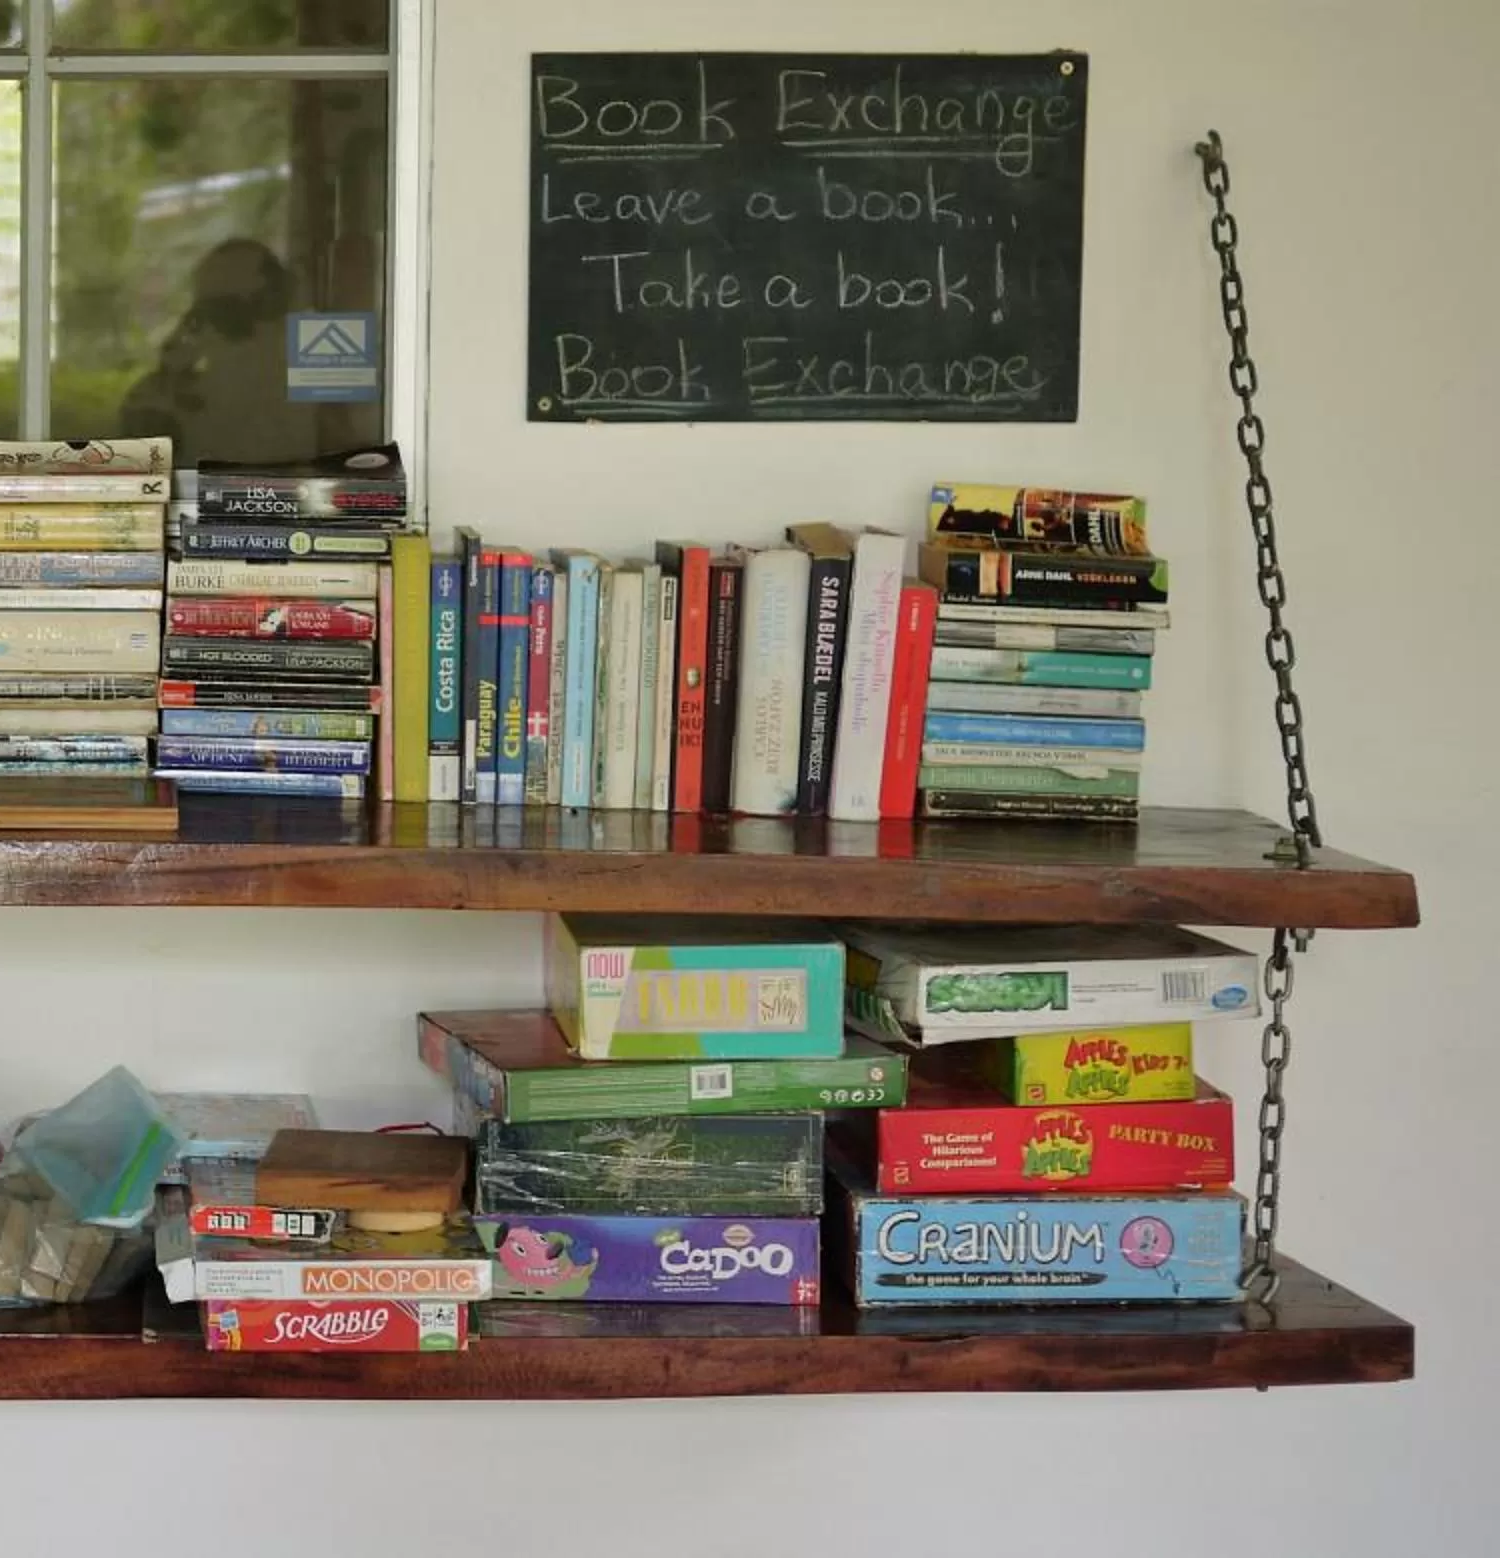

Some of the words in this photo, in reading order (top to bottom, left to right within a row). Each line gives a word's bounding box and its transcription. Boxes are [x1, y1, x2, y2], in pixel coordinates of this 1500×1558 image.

[536, 60, 736, 139] Book
[776, 63, 1077, 177] Exchange
[540, 173, 713, 225] Leave
[745, 191, 795, 221] a
[581, 247, 742, 313] Take
[764, 274, 812, 308] a
[556, 334, 710, 398] Book
[742, 330, 1048, 402] Exchange
[225, 501, 297, 513] JACKSON
[247, 487, 277, 499] LISA
[175, 575, 225, 589] BURKE
[819, 576, 840, 621] SARA
[436, 610, 456, 652] Rica
[812, 623, 837, 685] BLÆDEL
[435, 657, 456, 713] Costa
[477, 679, 497, 758] Paraguay
[503, 696, 522, 758] Chile
[923, 1133, 945, 1144] The
[947, 1133, 980, 1144] Game
[982, 1131, 994, 1142] of
[932, 1145, 984, 1156] Hilarious
[1108, 1124, 1174, 1146] PARTY
[1176, 1130, 1219, 1152] BOX
[928, 1276, 960, 1287] game
[962, 1274, 981, 1285] for
